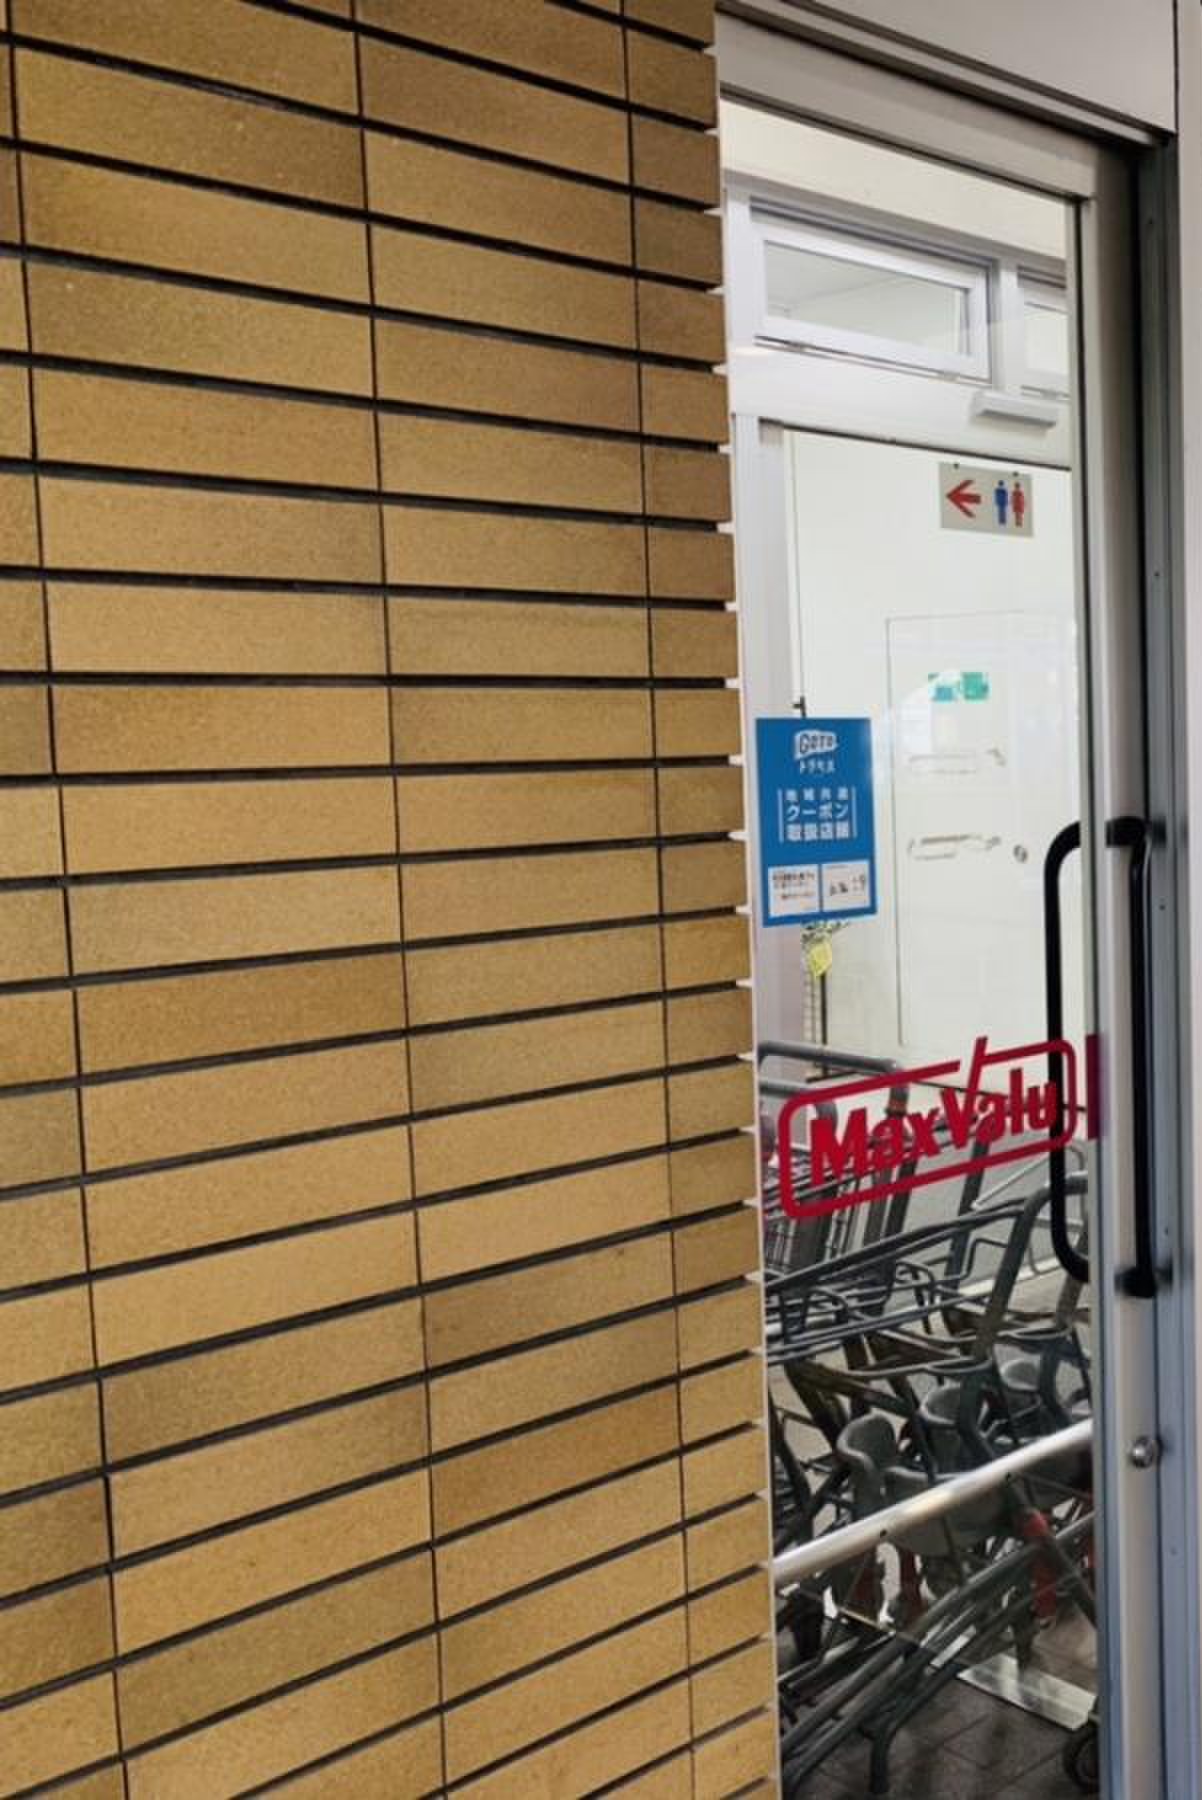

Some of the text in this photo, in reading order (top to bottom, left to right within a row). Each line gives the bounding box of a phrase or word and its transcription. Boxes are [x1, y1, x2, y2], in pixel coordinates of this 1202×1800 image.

[786, 803, 849, 821] クーポン
[809, 1036, 1060, 1187] MaxValu
